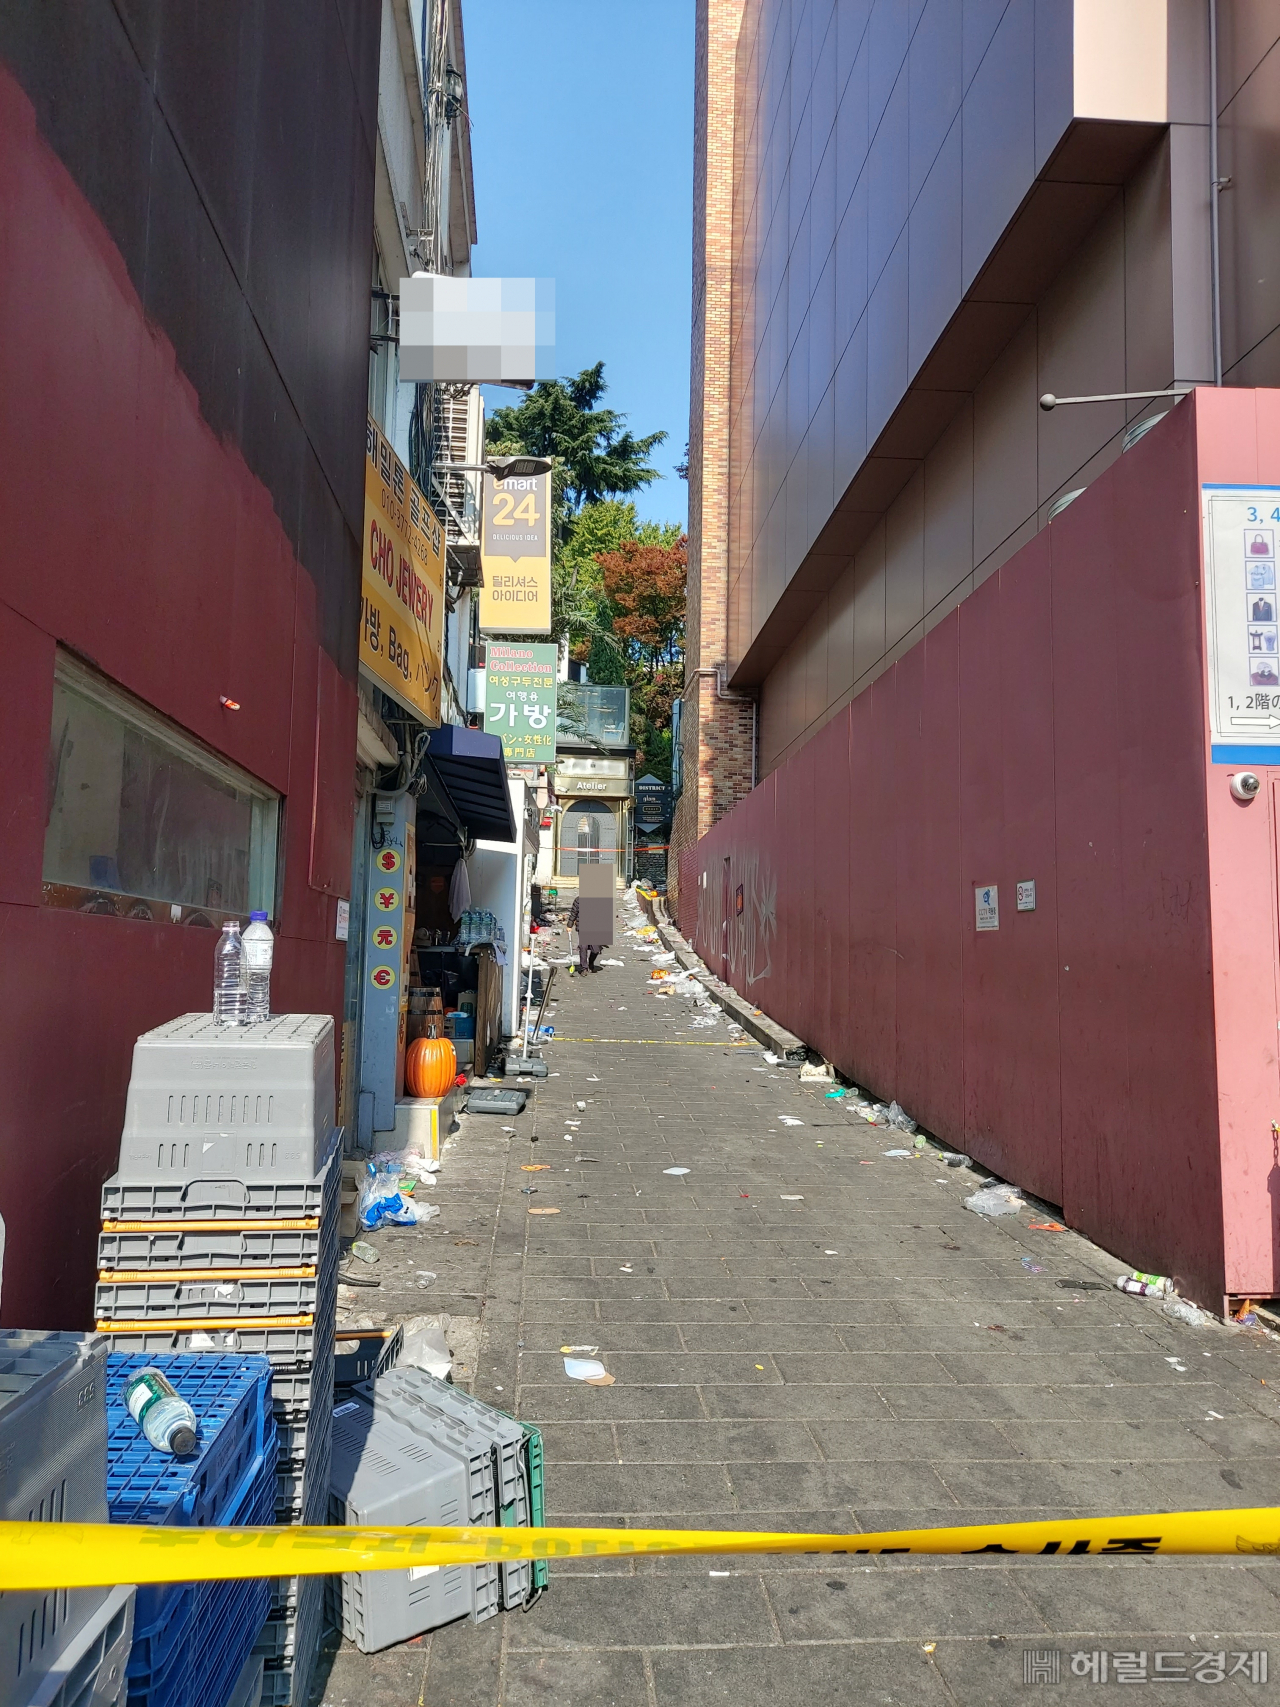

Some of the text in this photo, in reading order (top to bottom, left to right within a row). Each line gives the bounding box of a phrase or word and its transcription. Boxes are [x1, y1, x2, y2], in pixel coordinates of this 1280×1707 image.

[492, 492, 541, 527] 24
[492, 533, 523, 541] DELICIOUS
[370, 519, 434, 632] CHO JEWERY
[492, 575, 538, 588] 딜리셔스
[492, 590, 538, 602] 아이디어
[388, 625, 412, 682] Bag,
[490, 646, 534, 659] Milano
[490, 660, 553, 673] Collection
[489, 675, 553, 689] 여성구두전문
[506, 691, 539, 702] 여행용
[489, 703, 552, 729] 가방
[576, 781, 607, 791] Atelier
[377, 930, 393, 945] 元
